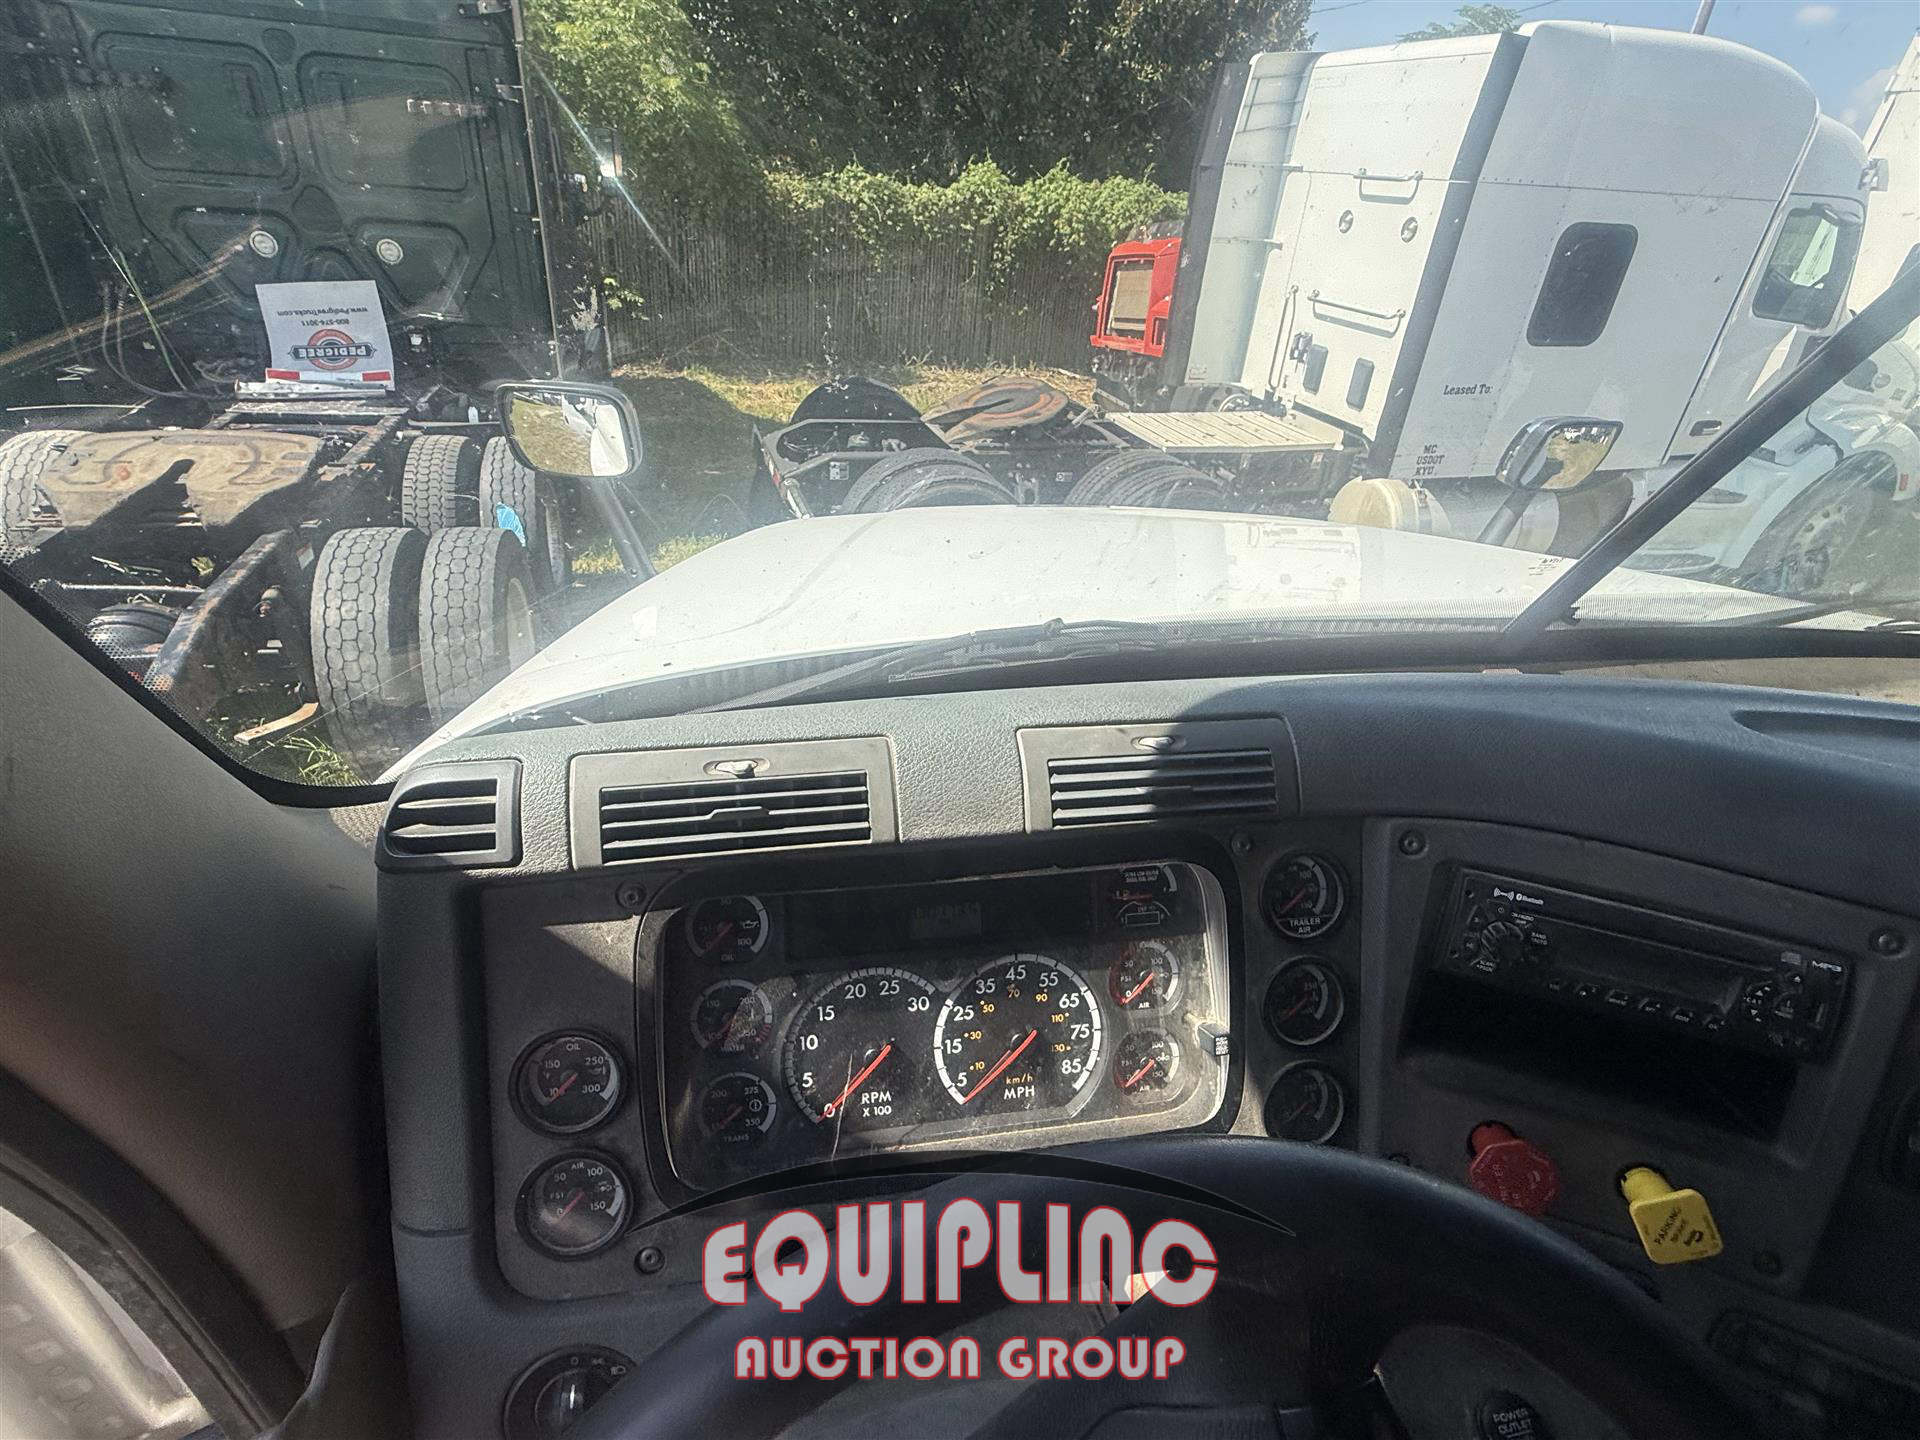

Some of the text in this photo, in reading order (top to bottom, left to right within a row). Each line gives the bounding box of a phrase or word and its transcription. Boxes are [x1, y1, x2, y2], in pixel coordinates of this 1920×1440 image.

[298, 345, 366, 358] PEDIGREE
[1443, 384, 1477, 395] Leased
[1424, 444, 1438, 454] MC
[1416, 455, 1445, 465] USDOT
[1415, 466, 1435, 475] KYU
[1288, 917, 1320, 927] TRAILER
[1298, 926, 1311, 934] AIR
[721, 953, 735, 961] OIL
[1151, 957, 1163, 965] 100
[1812, 960, 1843, 972] MP3
[1005, 965, 1026, 981] 45
[1039, 972, 1059, 987] 55
[844, 983, 866, 999] 20
[879, 980, 900, 995] 25
[976, 978, 996, 994] 35
[1008, 988, 1020, 998] 70
[1035, 993, 1048, 1002] 90
[907, 996, 930, 1012] 30
[1059, 993, 1080, 1008] 65
[816, 1005, 835, 1021] 15
[953, 1005, 975, 1021] 25
[982, 1003, 995, 1013] 50
[1051, 1014, 1064, 1022] 110
[970, 1031, 982, 1039] 30
[1070, 1024, 1090, 1040] 75
[566, 1042, 581, 1051] OIL
[799, 1034, 818, 1050] 10
[944, 1038, 962, 1054] 15
[545, 1060, 560, 1068] 150
[975, 1062, 985, 1070] 10
[1061, 1059, 1081, 1074] 85
[802, 1072, 813, 1087] 5
[957, 1072, 967, 1087] 5
[1006, 1073, 1033, 1084] km/h
[582, 1083, 600, 1093] 300
[711, 1089, 728, 1098] 200
[744, 1086, 759, 1095] 275
[1003, 1086, 1035, 1099] MPH
[861, 1091, 892, 1104] RPM
[824, 1103, 835, 1117] 0
[874, 1105, 892, 1116] 100
[745, 1119, 761, 1127] 350
[723, 1133, 750, 1142] TRANS
[571, 1161, 584, 1170] AIR
[587, 1166, 603, 1177] 100
[554, 1173, 567, 1182] 50
[590, 1201, 606, 1210] 150
[1493, 1407, 1529, 1423] POWER
[1498, 1418, 1532, 1436] OUTLET
